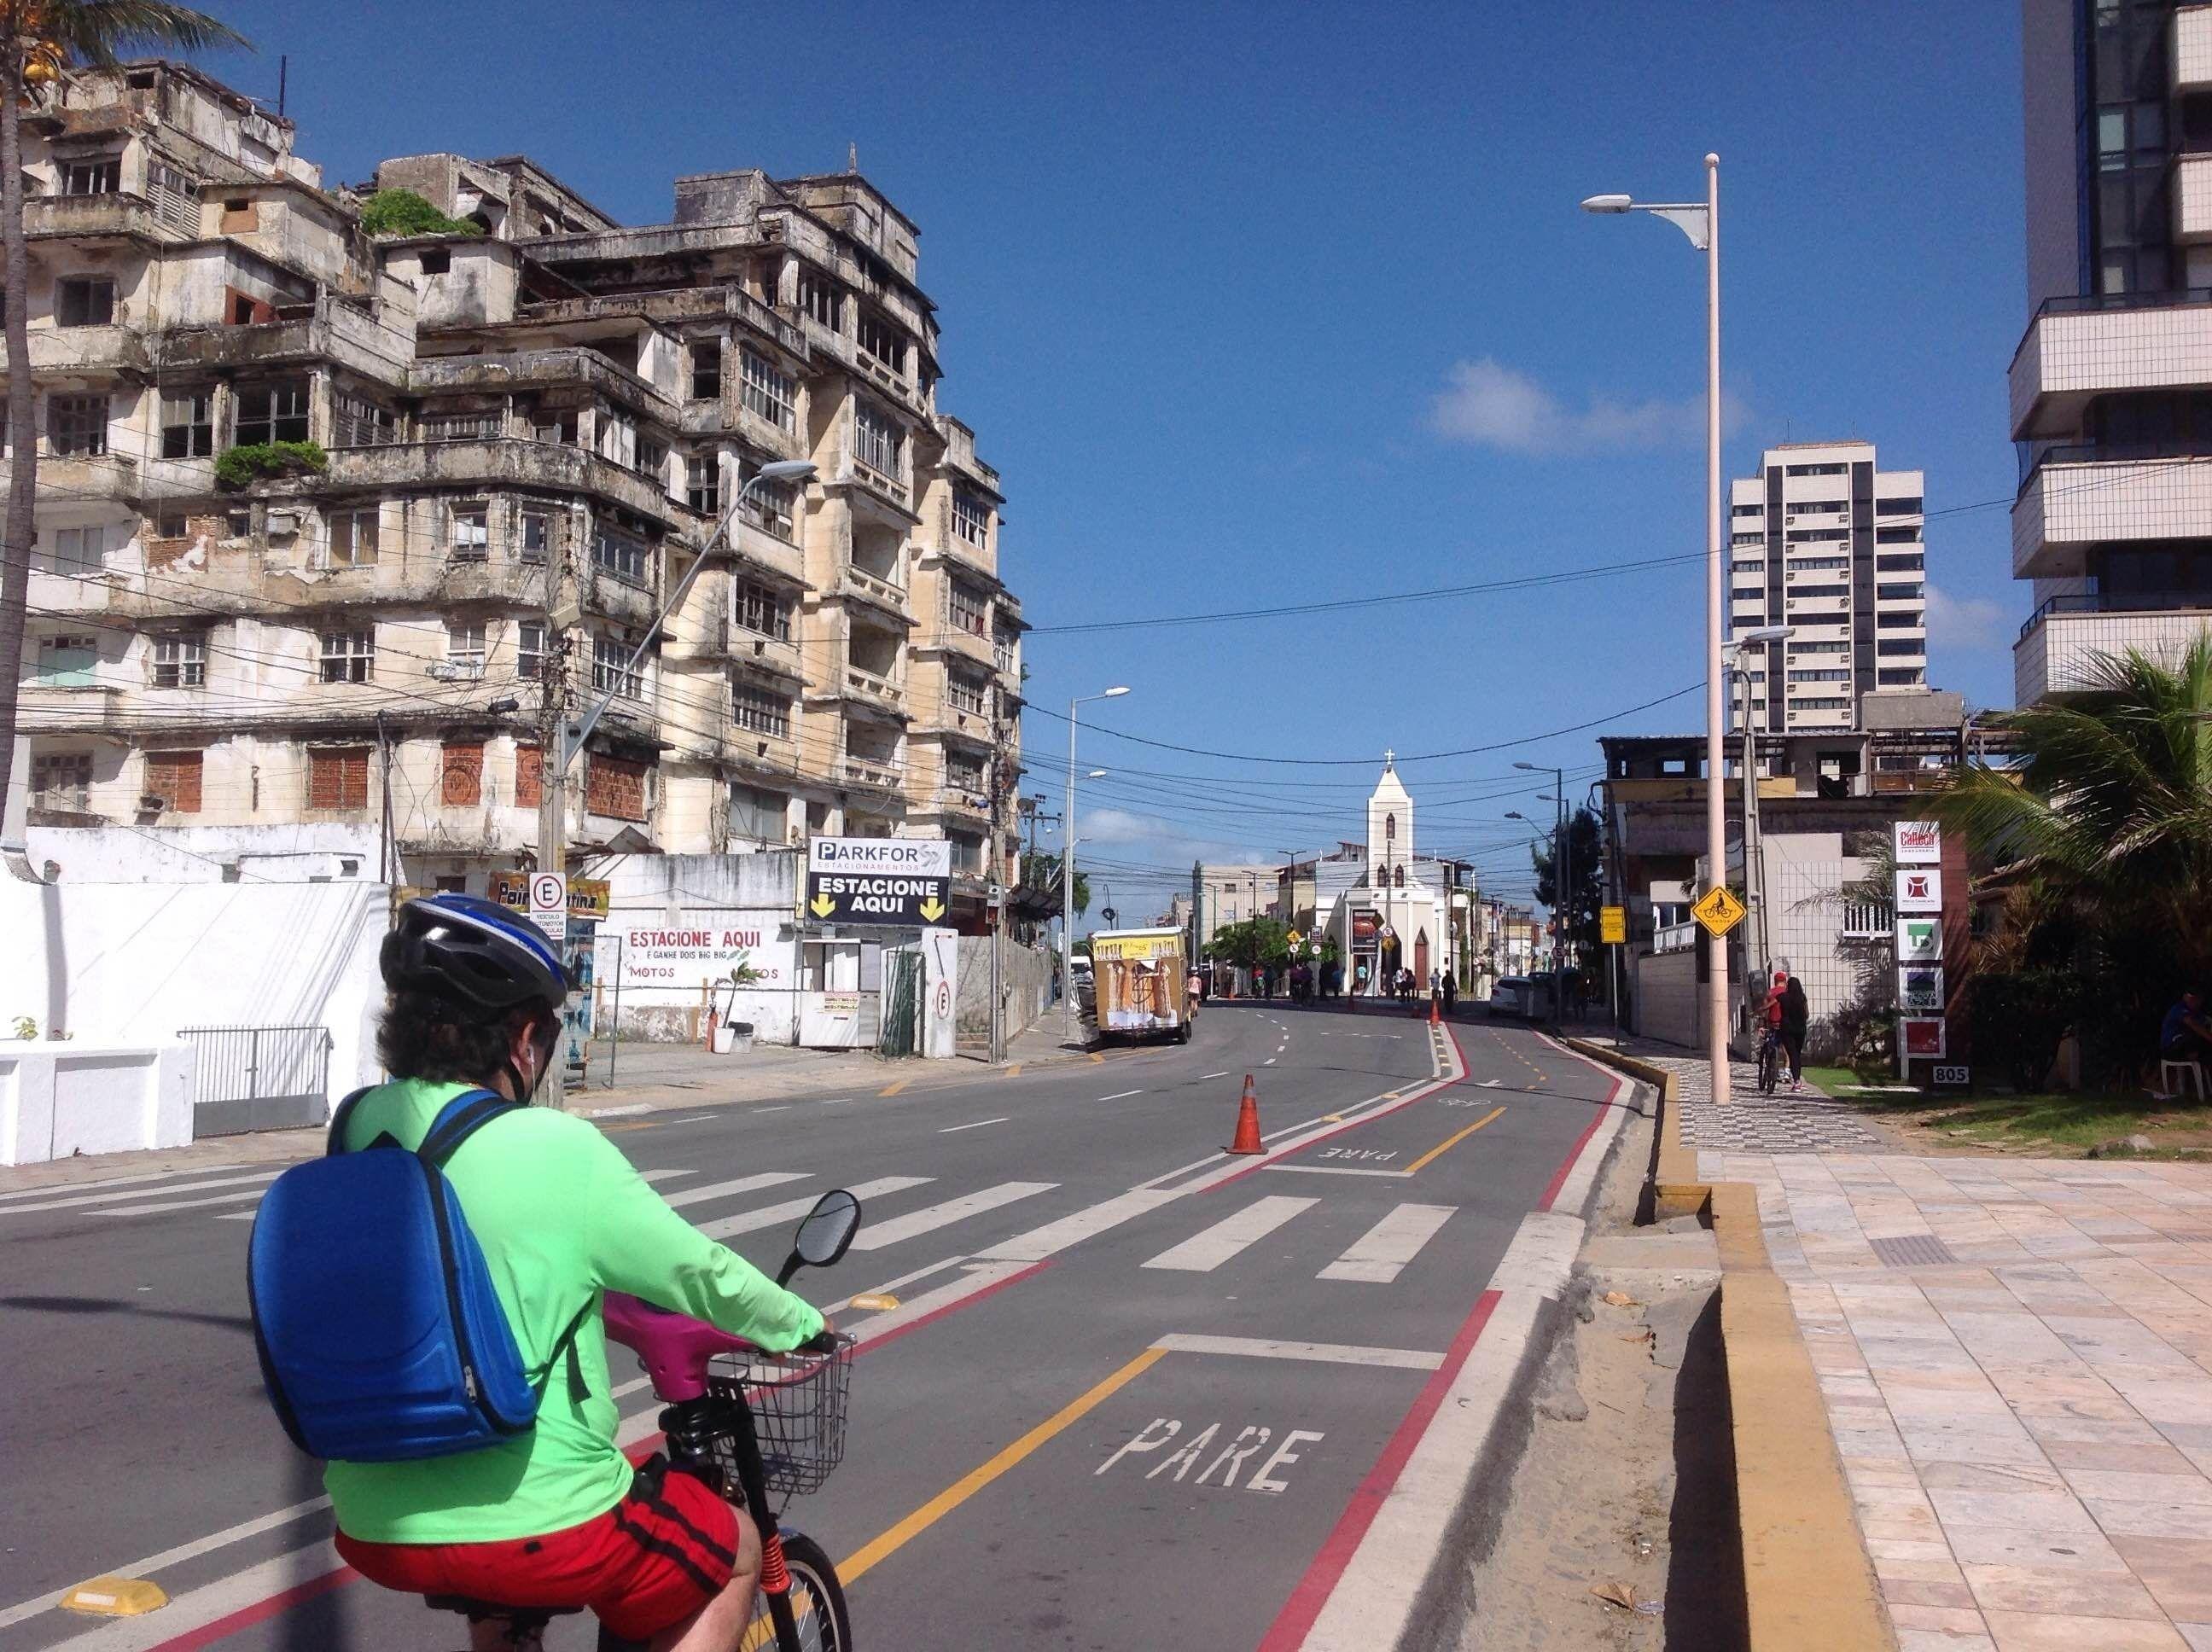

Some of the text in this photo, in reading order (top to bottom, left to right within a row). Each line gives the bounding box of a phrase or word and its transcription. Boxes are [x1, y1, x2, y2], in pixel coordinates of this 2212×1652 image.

[818, 841, 919, 863] PARKFOR
[817, 862, 921, 872] ESTACIONAMENTOS
[542, 882, 553, 901] E
[818, 877, 939, 897] ESTACIONE
[850, 896, 905, 914] AQUI
[630, 930, 761, 950] ESTACIONE AQUI
[713, 951, 727, 960] BIG
[630, 968, 675, 978] MOTOS
[1935, 1067, 1966, 1082] 805
[1093, 1417, 1325, 1492] PARE
